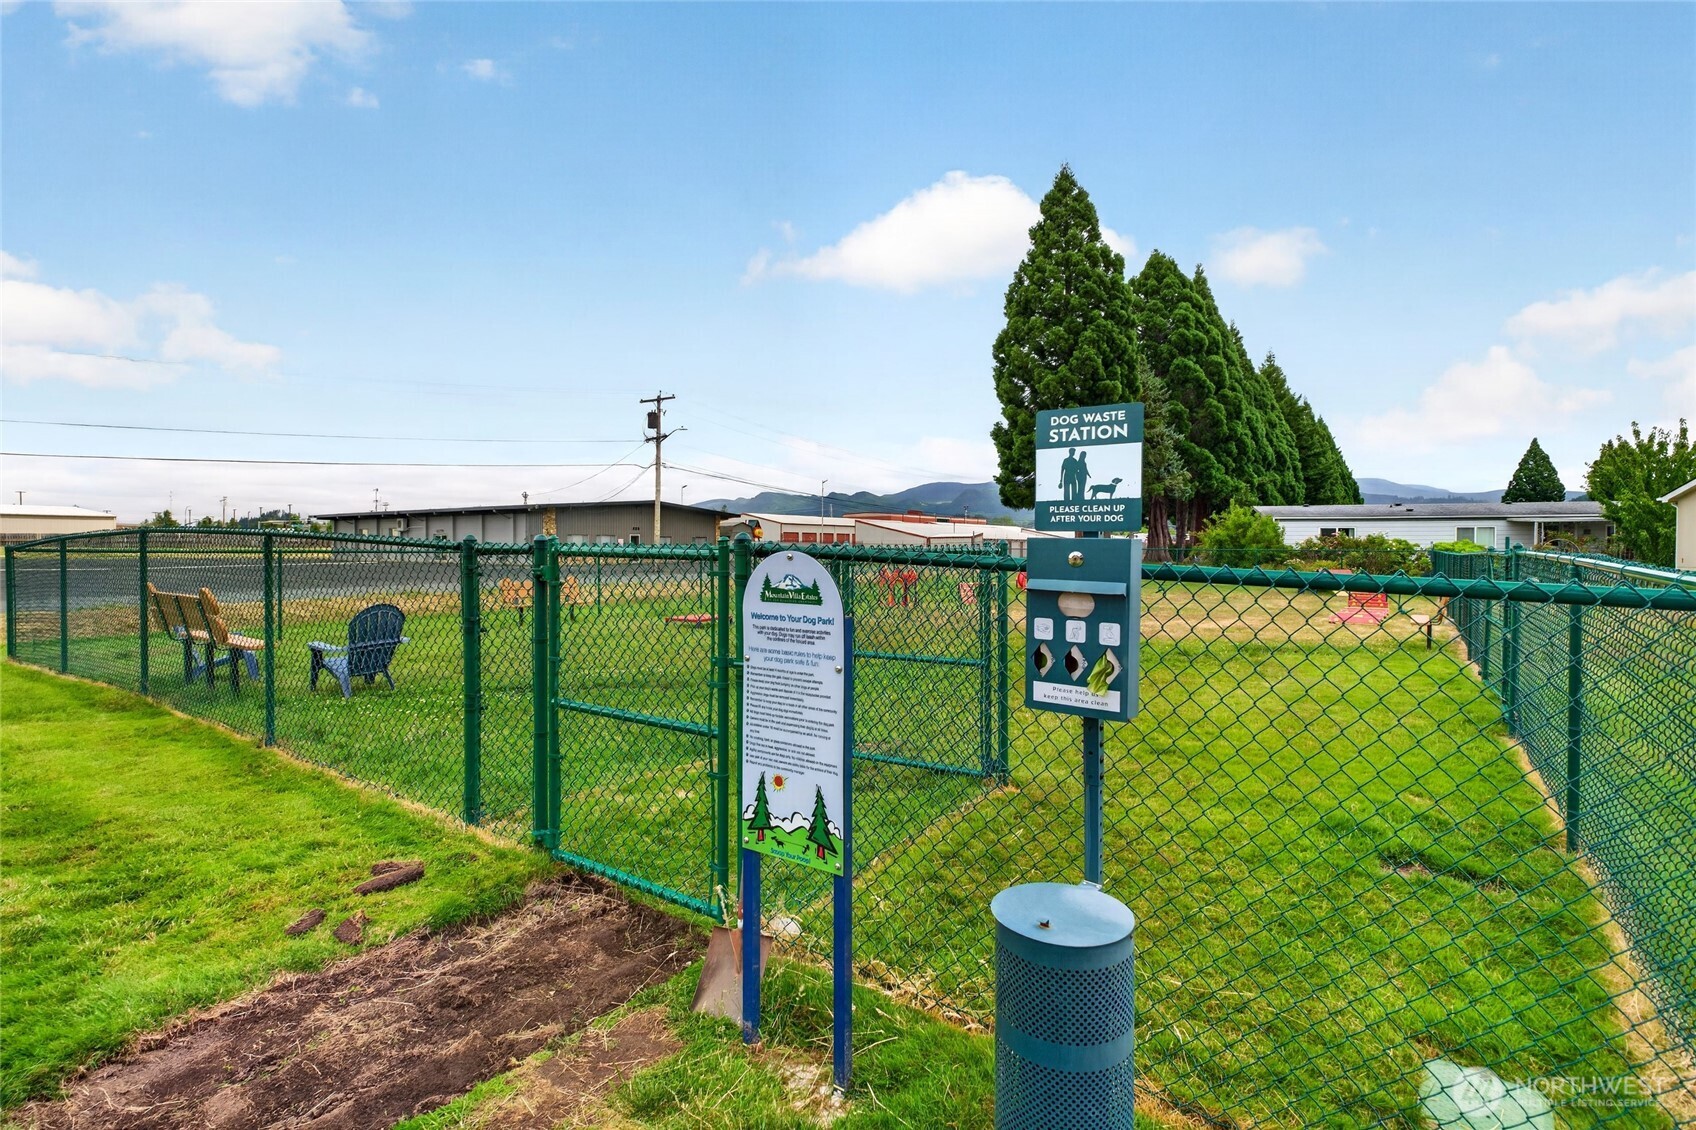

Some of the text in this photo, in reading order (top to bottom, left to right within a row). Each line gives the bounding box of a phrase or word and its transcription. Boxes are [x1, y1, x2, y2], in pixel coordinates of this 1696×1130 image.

[1050, 410, 1126, 426] DOG WASTE
[1048, 423, 1128, 443] STATION
[1049, 504, 1126, 513] PLEASE CLEAN UP
[1050, 515, 1076, 523] AFTER
[1077, 514, 1102, 522] YOUR
[750, 612, 779, 622] Welcome
[787, 614, 802, 623] Your
[802, 615, 816, 626] Dog
[817, 616, 835, 626] Park!
[770, 848, 785, 857] Scoop
[796, 855, 810, 864] Poop!
